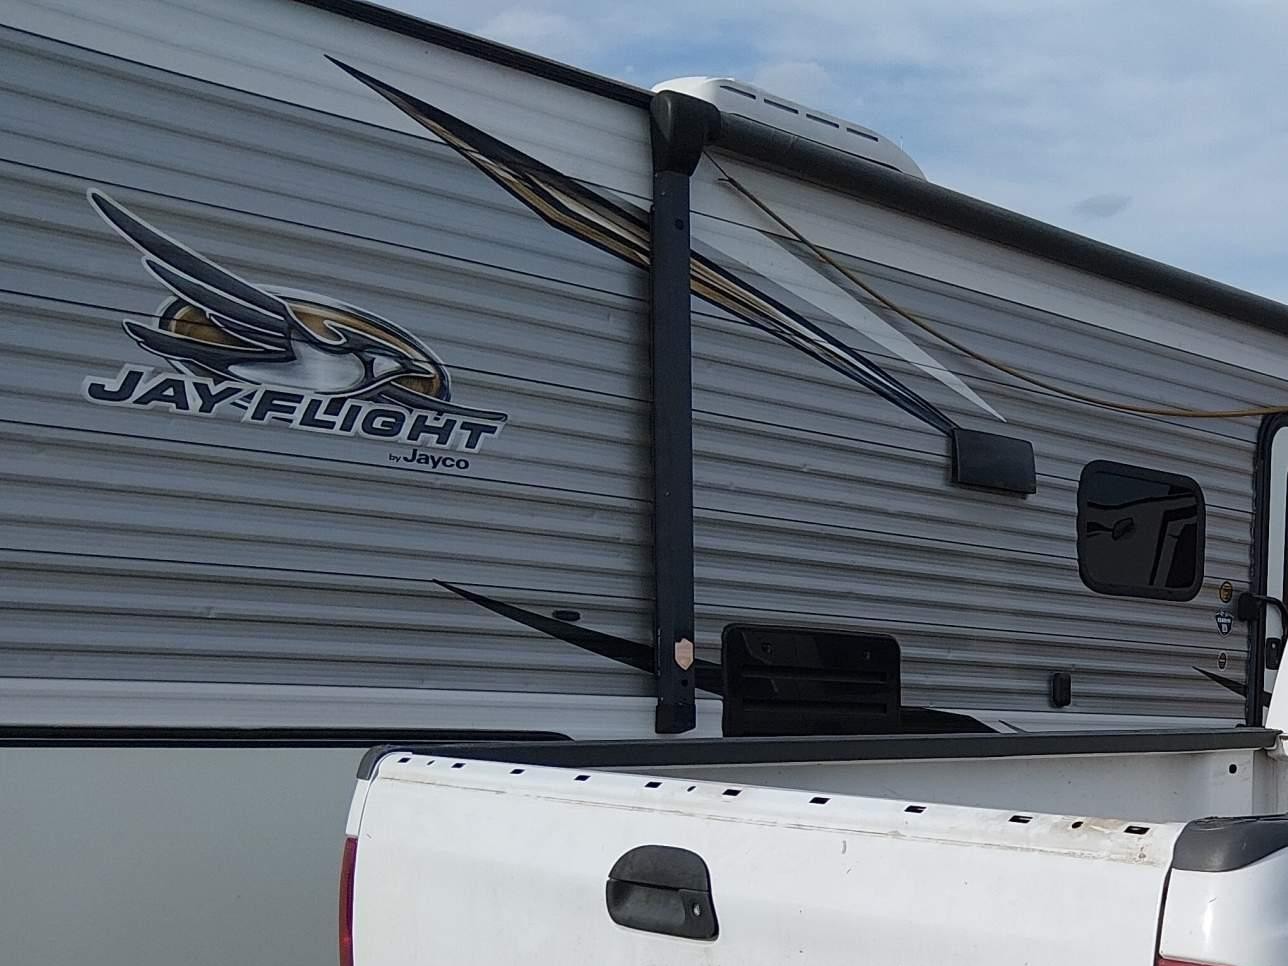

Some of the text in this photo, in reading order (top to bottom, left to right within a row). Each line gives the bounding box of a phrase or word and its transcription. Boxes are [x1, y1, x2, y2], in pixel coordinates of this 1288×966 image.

[86, 369, 498, 451] JAY FLIGHT
[388, 449, 469, 470] by Jayco
